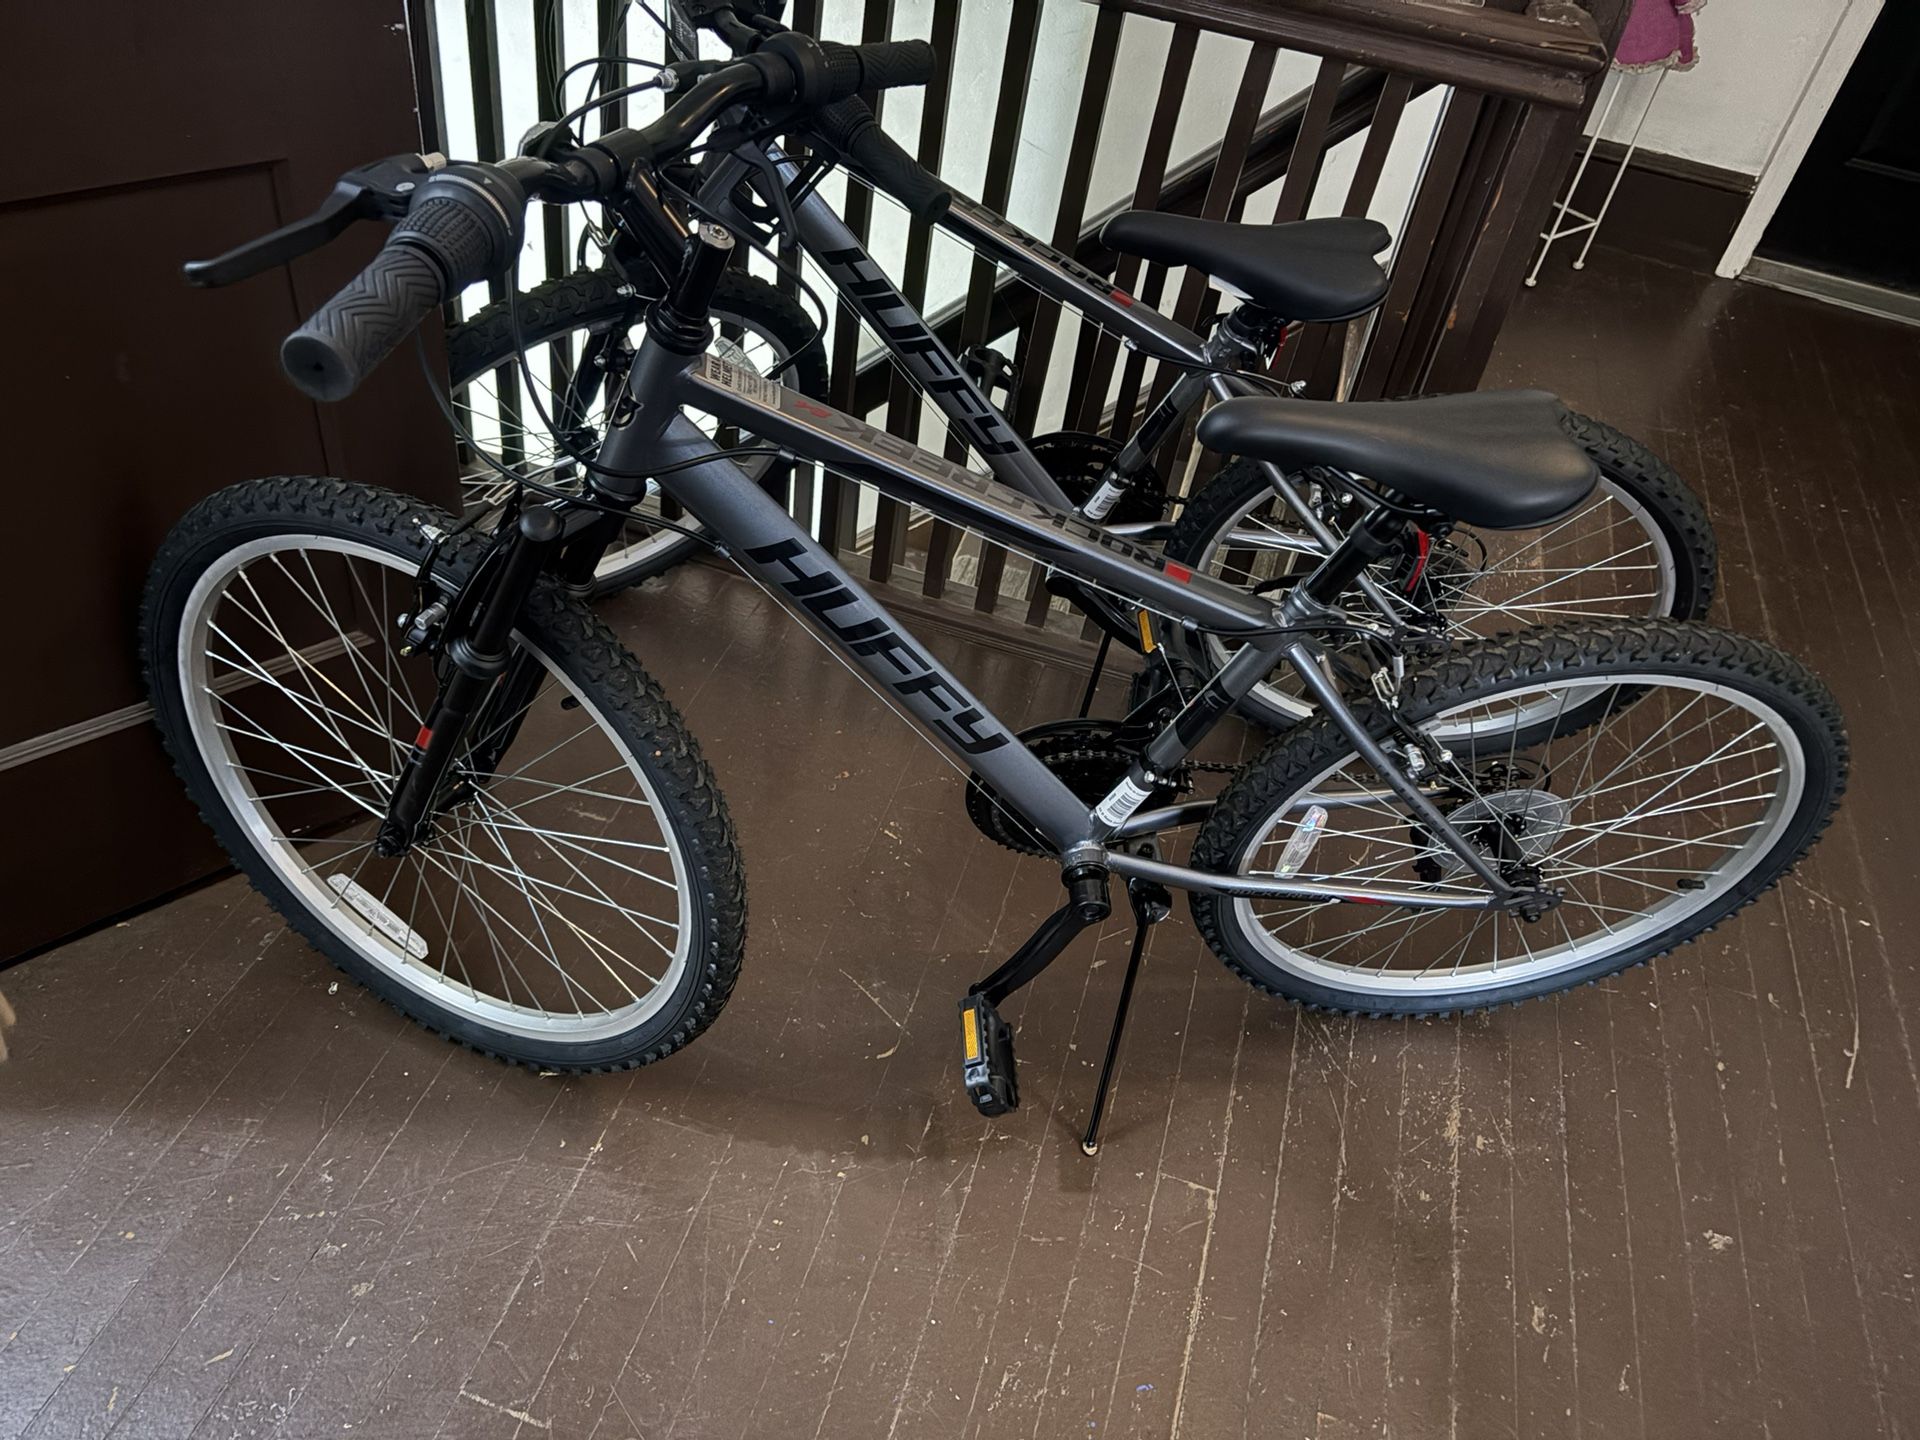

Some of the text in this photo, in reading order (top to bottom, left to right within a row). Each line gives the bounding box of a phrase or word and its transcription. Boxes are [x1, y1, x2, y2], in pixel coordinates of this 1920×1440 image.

[1006, 226, 1115, 294] ROCK
[710, 361, 721, 381] WEAR
[721, 361, 732, 387] HELMET
[821, 247, 1020, 455] HUFFY
[832, 413, 1032, 509] CREEK
[1030, 501, 1166, 570] ROCK
[743, 537, 1010, 754] HUFFY
